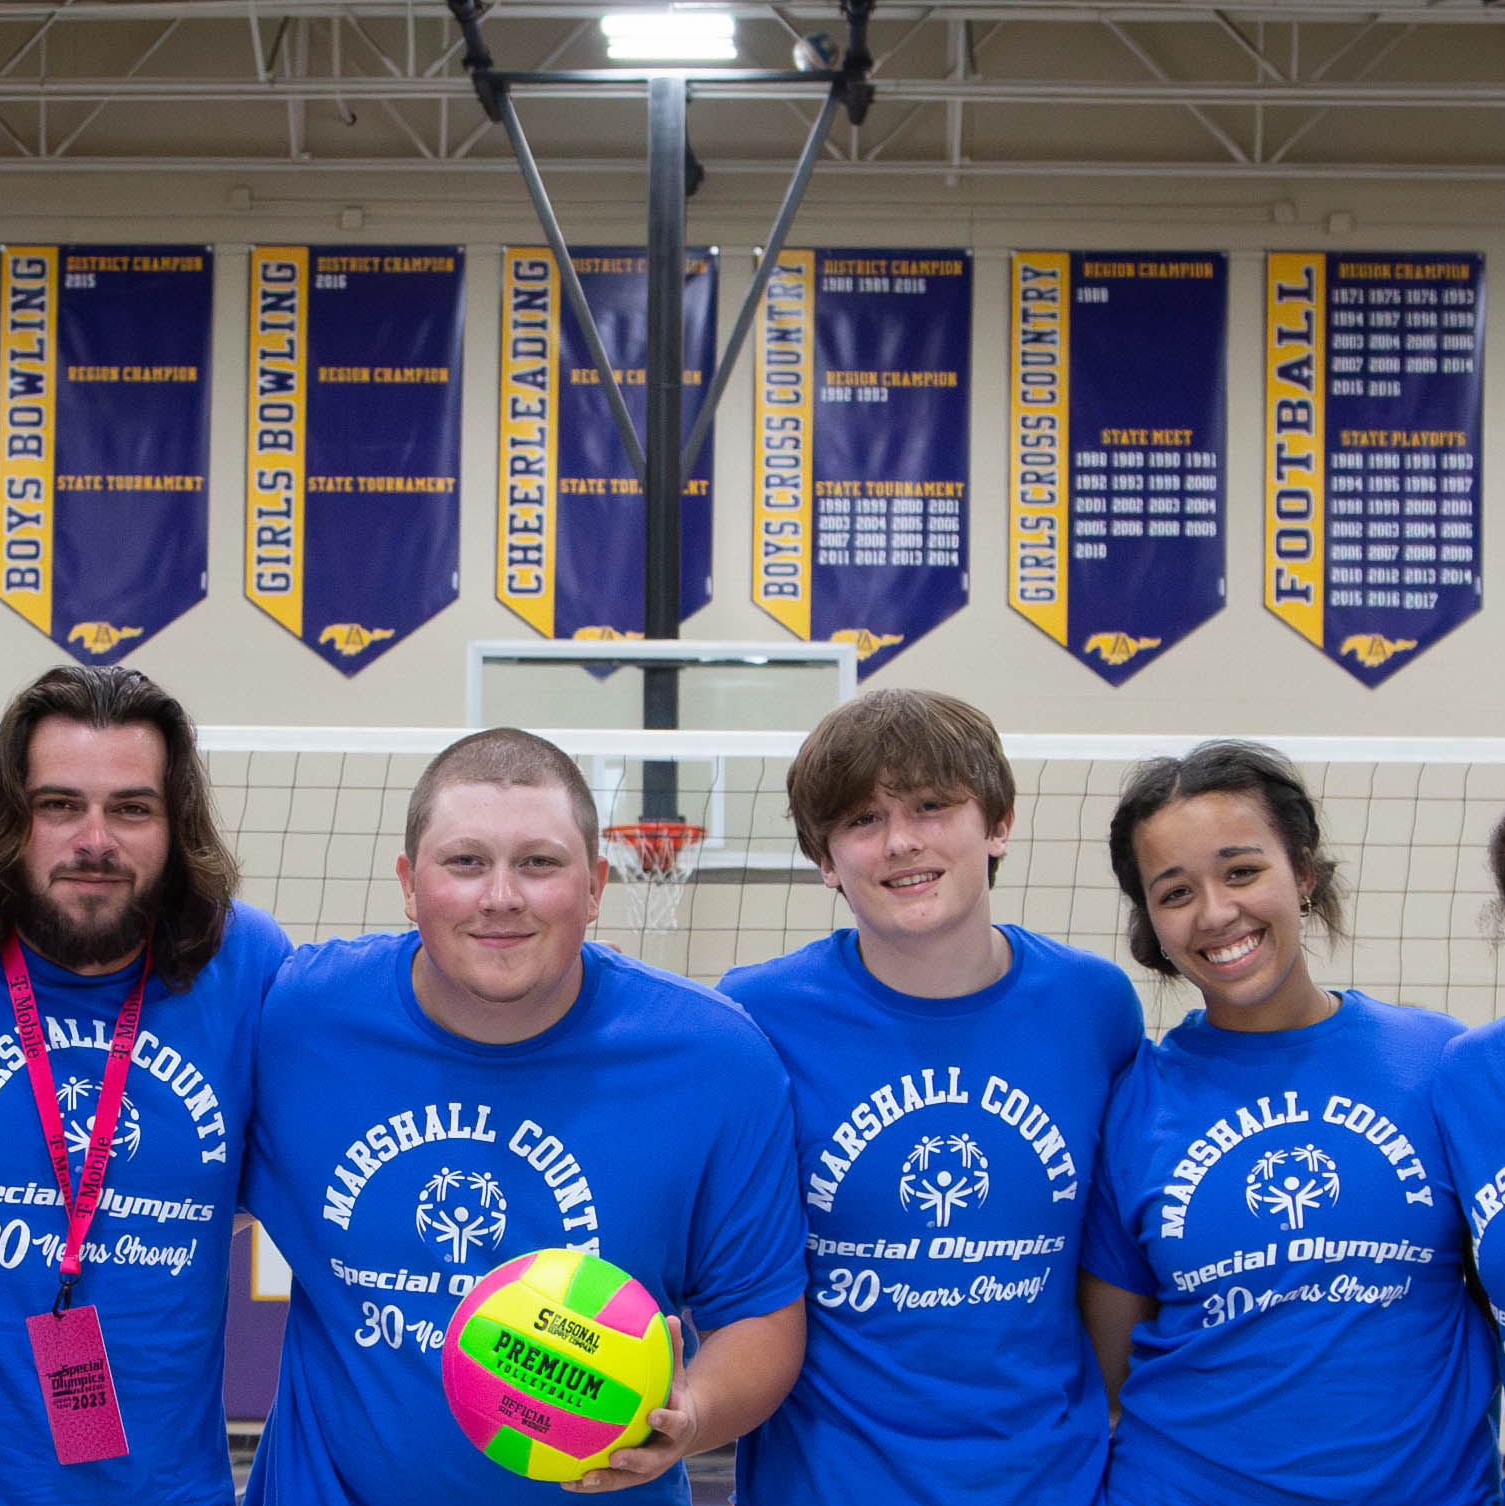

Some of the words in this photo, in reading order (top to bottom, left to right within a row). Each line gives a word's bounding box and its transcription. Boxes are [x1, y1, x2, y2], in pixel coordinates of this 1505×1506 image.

[67, 257, 127, 271] DISTRICT
[132, 257, 203, 271] CHAMPION
[317, 257, 377, 272] DISTRICT
[383, 257, 454, 272] CHAMPION
[824, 260, 887, 275] DISTRICT
[892, 260, 962, 276] CHAMPION
[7, 255, 50, 461] BOWLING
[258, 259, 299, 455] BOWLING
[765, 263, 806, 407] COUNTRY
[1020, 263, 1060, 407] COUNTRY
[68, 367, 118, 382] REGION
[123, 367, 197, 382] CHAMPION
[319, 367, 368, 383] REGION
[374, 367, 448, 383] CHAMPION
[827, 372, 877, 387] REGION
[882, 372, 957, 387] CHAMPION
[505, 257, 551, 597] CHEERLEADING
[1101, 430, 1147, 445] STATE
[1152, 430, 1192, 445] MEET
[1274, 265, 1316, 607] FOOTBALL
[1342, 431, 1387, 446] STATE
[1391, 431, 1466, 447] PLAYOFFS
[57, 476, 103, 491] STATE
[107, 476, 204, 491] TOURNAMENT
[764, 415, 801, 513] CROSS
[1019, 413, 1058, 507] CROSS
[308, 477, 354, 492] STATE
[358, 477, 455, 493] TOURNAMENT
[560, 478, 606, 494] STATE
[816, 481, 861, 497] STATE
[866, 481, 964, 498] TOURNAMENT
[5, 475, 44, 594] BOYS
[255, 467, 293, 595] GIRLS
[762, 519, 801, 600] BOYS
[1019, 515, 1057, 604] GIRLS
[14, 995, 39, 1059] Mobile
[131, 1030, 227, 1164] COUNTY
[807, 1066, 968, 1213] MARSHALL
[981, 1076, 1078, 1203] COUNTY
[83, 1136, 111, 1196] Mobile
[323, 1102, 496, 1231] MARSHALL
[508, 1119, 600, 1257] COUNTY
[1162, 1091, 1309, 1239] MARSHALL
[1322, 1096, 1433, 1207] COUNTY
[96, 1188, 214, 1223] lympics
[33, 1233, 111, 1268] Yers
[113, 1234, 197, 1276] Strong!
[806, 1234, 920, 1260] Special
[928, 1234, 1065, 1263] Olympics
[1172, 1243, 1277, 1293] Special
[1288, 1237, 1435, 1264] Olympics
[330, 1257, 441, 1295] Special
[817, 1268, 880, 1313] 30
[883, 1282, 966, 1312] Years
[968, 1267, 1051, 1304] Strong!
[355, 1301, 404, 1350] 30
[1202, 1286, 1254, 1329] 30
[1328, 1274, 1412, 1308] Strong!
[534, 1308, 600, 1348] SEASONAL
[52, 1374, 105, 1390] Olympics
[62, 1358, 103, 1376] Special
[494, 1331, 604, 1400] PREMIUM
[496, 1360, 582, 1408] VOLLEYBALL
[72, 1392, 106, 1410] 2023
[501, 1395, 550, 1428] OFFICIAL
